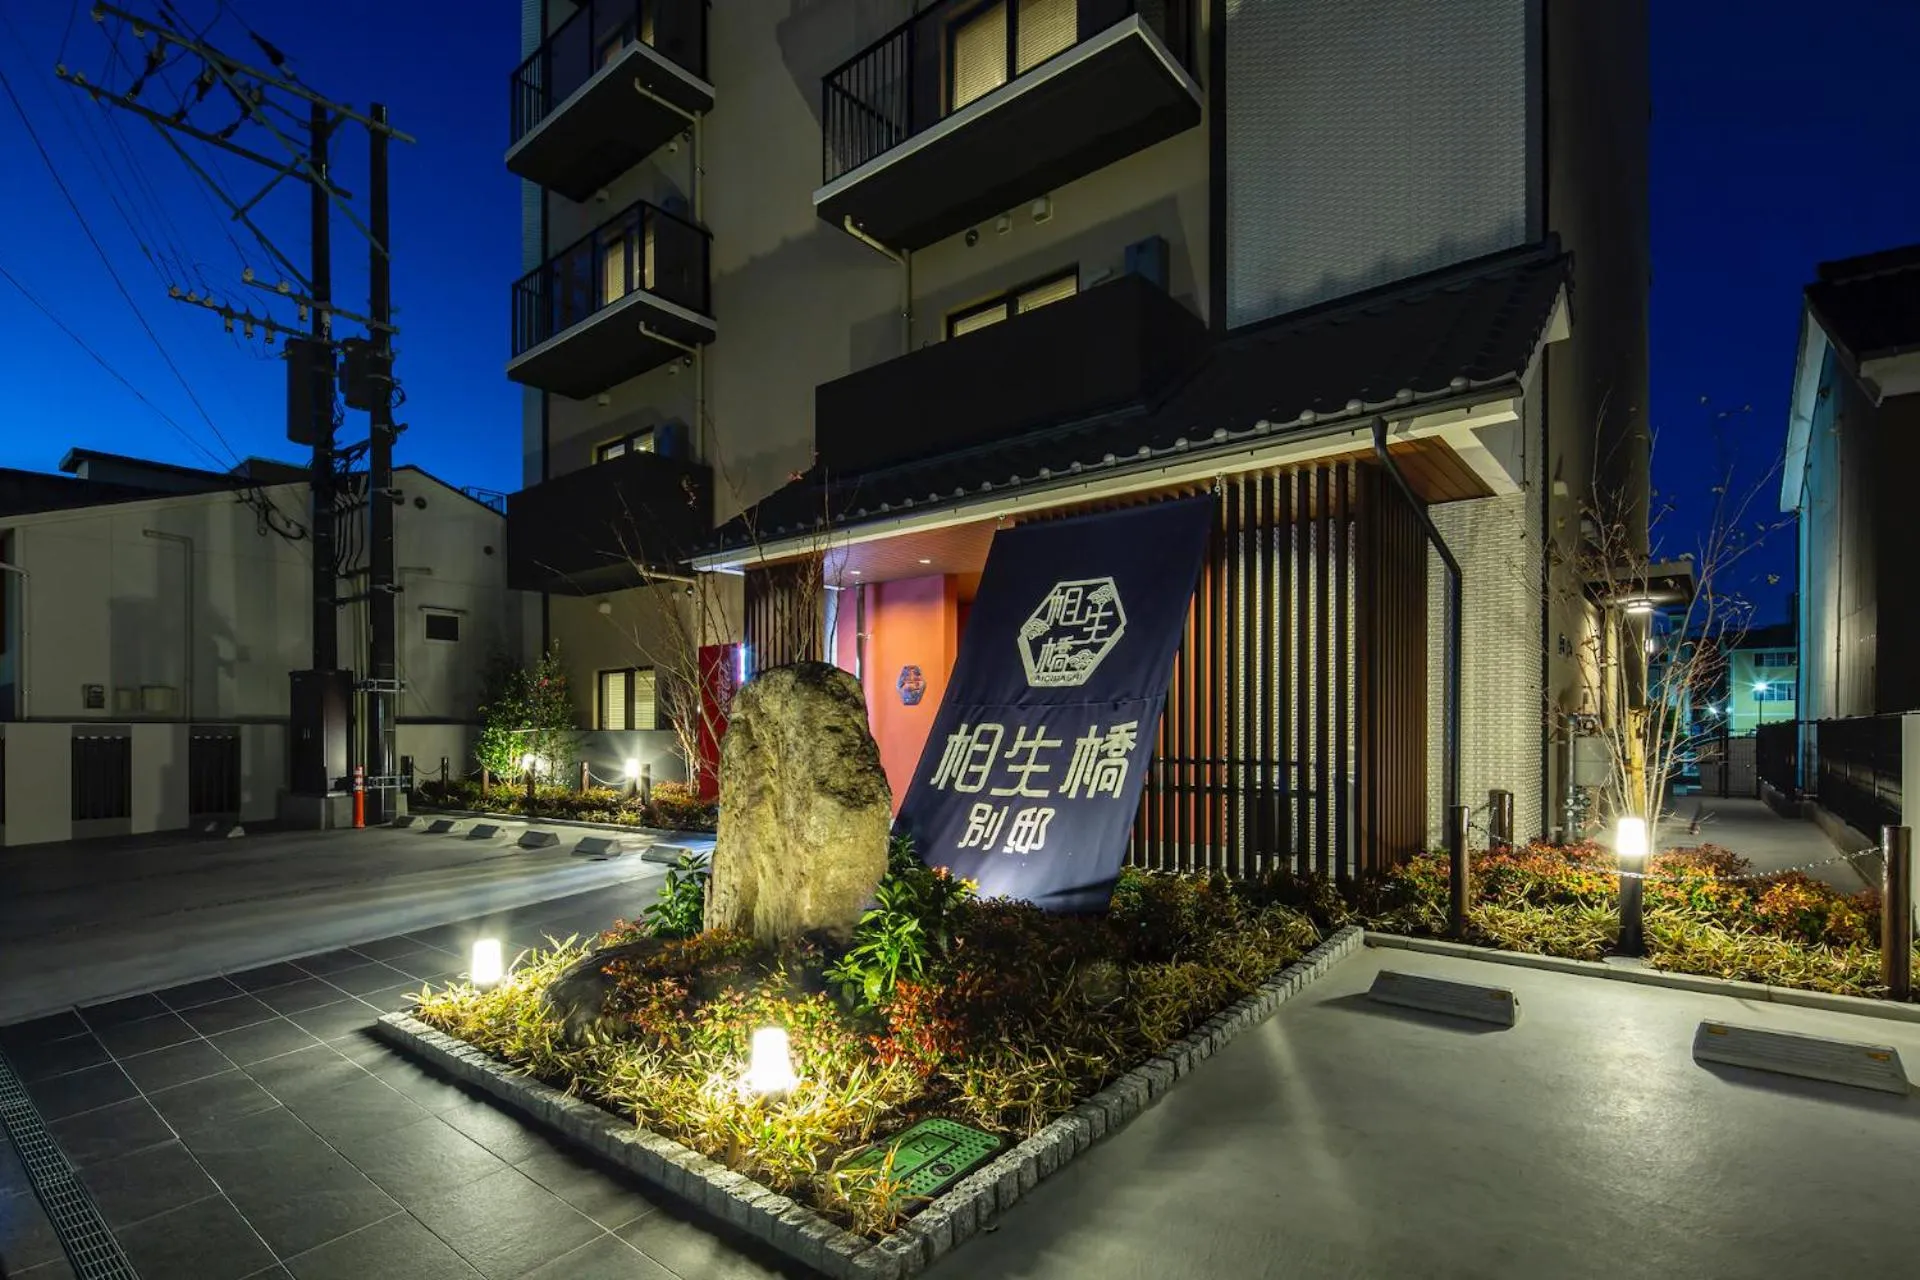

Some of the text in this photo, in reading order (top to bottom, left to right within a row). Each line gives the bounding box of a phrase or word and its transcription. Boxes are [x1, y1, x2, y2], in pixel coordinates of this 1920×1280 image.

[930, 720, 1139, 799] 相生橋
[957, 803, 1056, 854] 別邸
